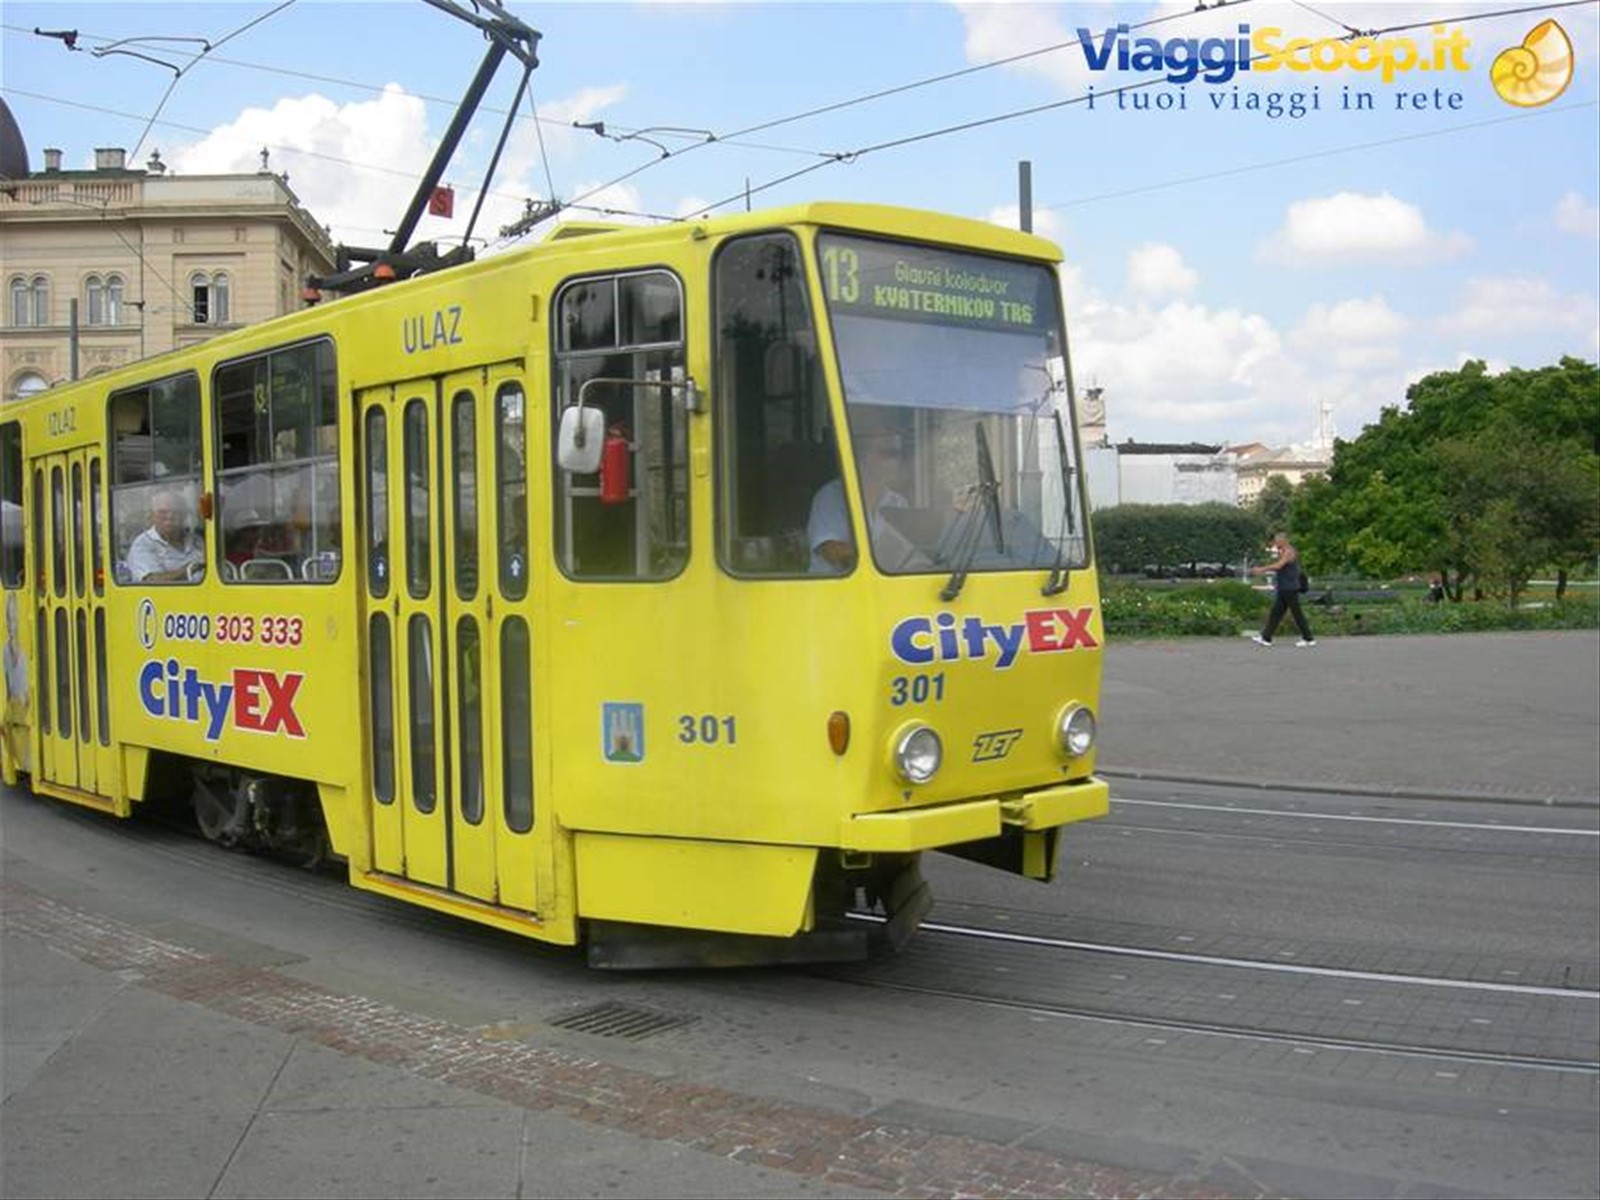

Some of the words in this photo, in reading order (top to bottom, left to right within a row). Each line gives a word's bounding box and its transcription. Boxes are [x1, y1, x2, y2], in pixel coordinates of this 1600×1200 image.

[824, 247, 859, 303] 13
[403, 305, 464, 354] ULAZ
[48, 406, 77, 437] IZLAZ
[164, 614, 210, 640] 0800
[215, 616, 255, 642] 303
[260, 617, 304, 646] 333
[892, 607, 1098, 668] CityEX
[139, 658, 306, 741] CityEX
[891, 673, 945, 706] 301
[678, 714, 736, 744] 301
[971, 728, 1024, 762] ZET
